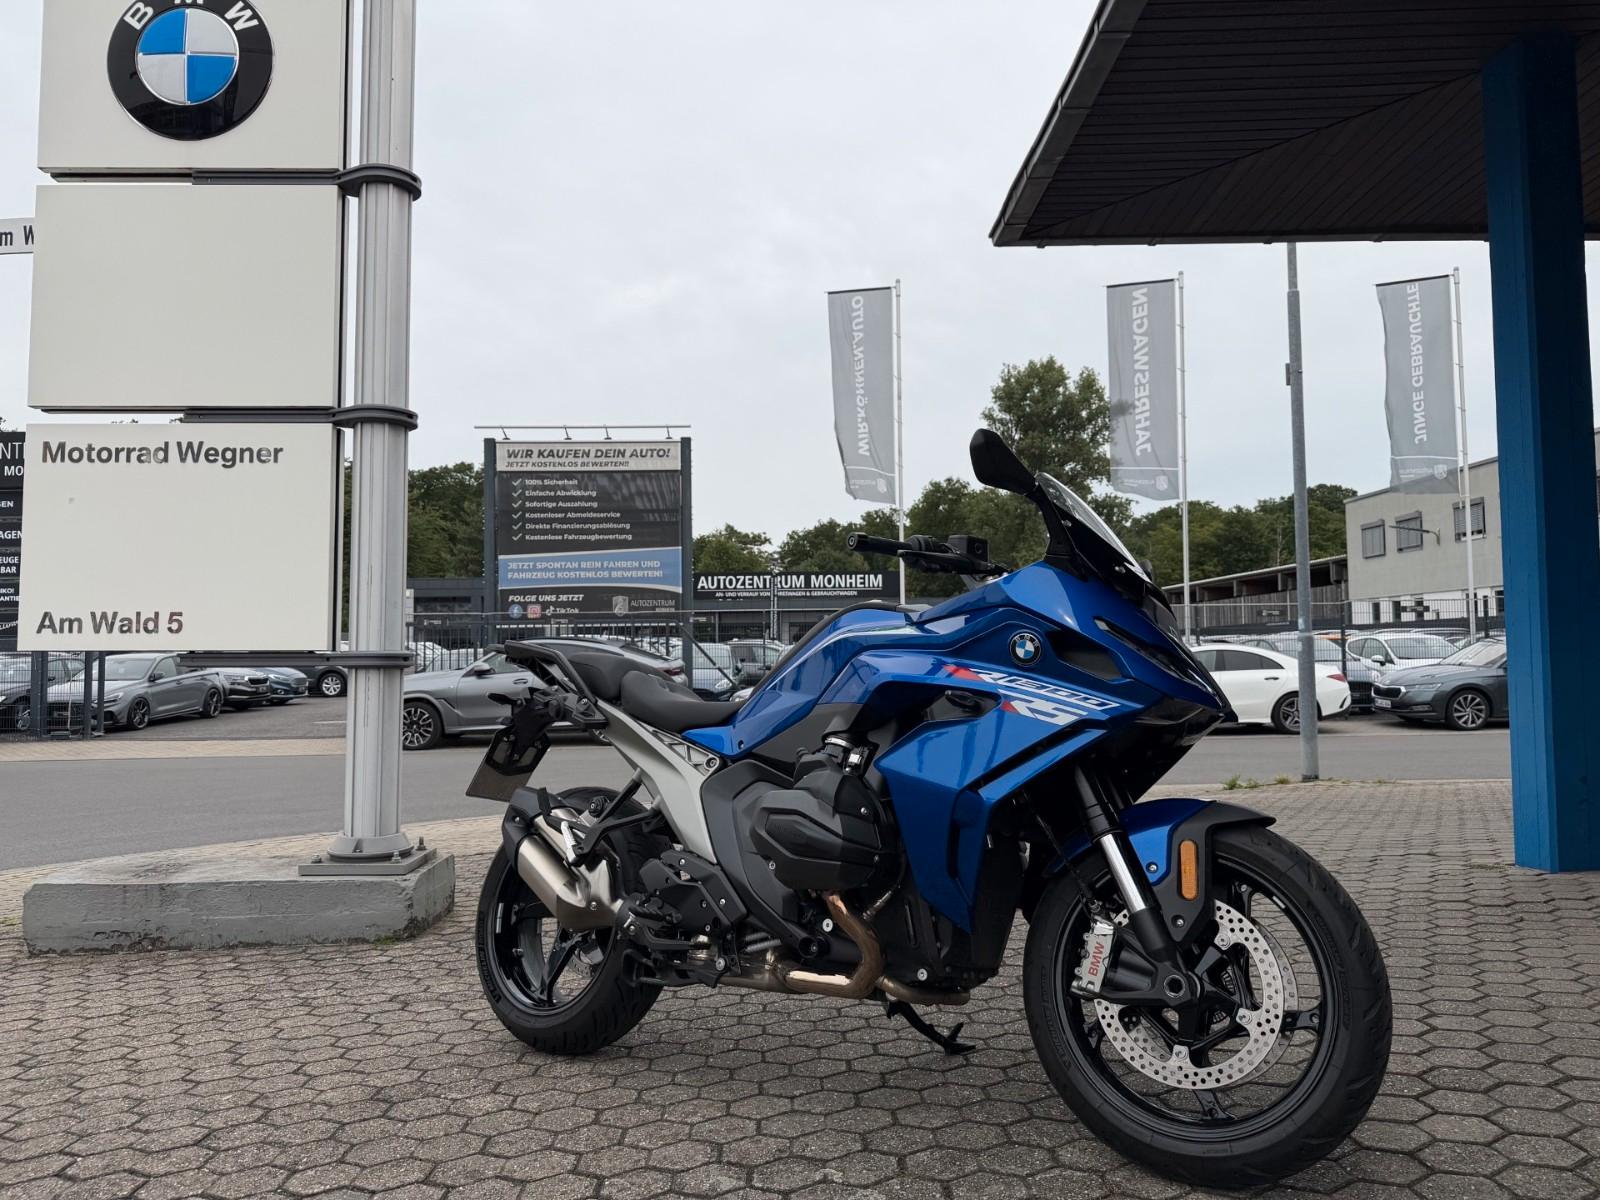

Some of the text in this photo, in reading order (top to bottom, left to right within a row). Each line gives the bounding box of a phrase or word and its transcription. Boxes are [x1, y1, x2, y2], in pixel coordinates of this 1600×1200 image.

[123, 0, 259, 31] BW
[42, 440, 284, 469] Motorrad Wegner
[506, 447, 671, 459] WIR KAUFEN DEIN AUTO!
[543, 478, 578, 486] Sicherheit
[525, 489, 597, 498] Einfache Abwicklung
[525, 500, 598, 508] Sofortige Auszahlung
[525, 522, 551, 530] Direkte
[564, 533, 633, 541] Fahrzeugbewertung
[507, 560, 661, 570] JETZT SPONTAN REIN FAHREN UND
[507, 570, 663, 579] FAHRZEUG KOSTENLOS BEWERTEN!
[810, 574, 883, 588] MONHEIM
[538, 594, 557, 602] UNS
[557, 594, 585, 602] JETZT
[36, 611, 83, 634] Am
[90, 611, 160, 634] Wald
[167, 611, 184, 634] 5
[1088, 942, 1105, 977] BMW
